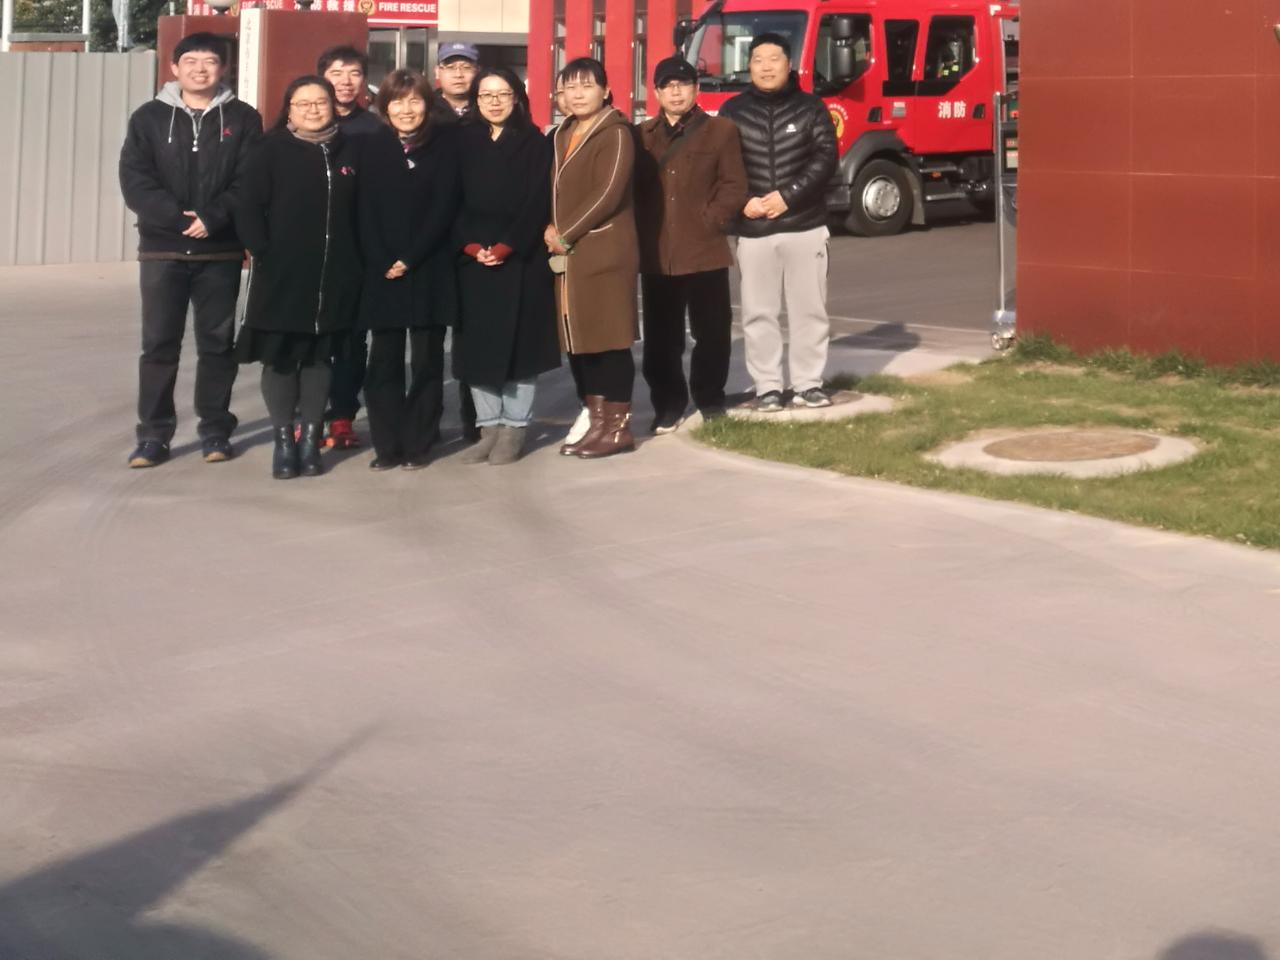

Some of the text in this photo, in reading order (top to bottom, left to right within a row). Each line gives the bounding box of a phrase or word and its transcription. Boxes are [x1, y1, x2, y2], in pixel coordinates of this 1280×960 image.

[379, 2, 436, 13] FIRE RESCUE
[938, 101, 966, 119] 消防
